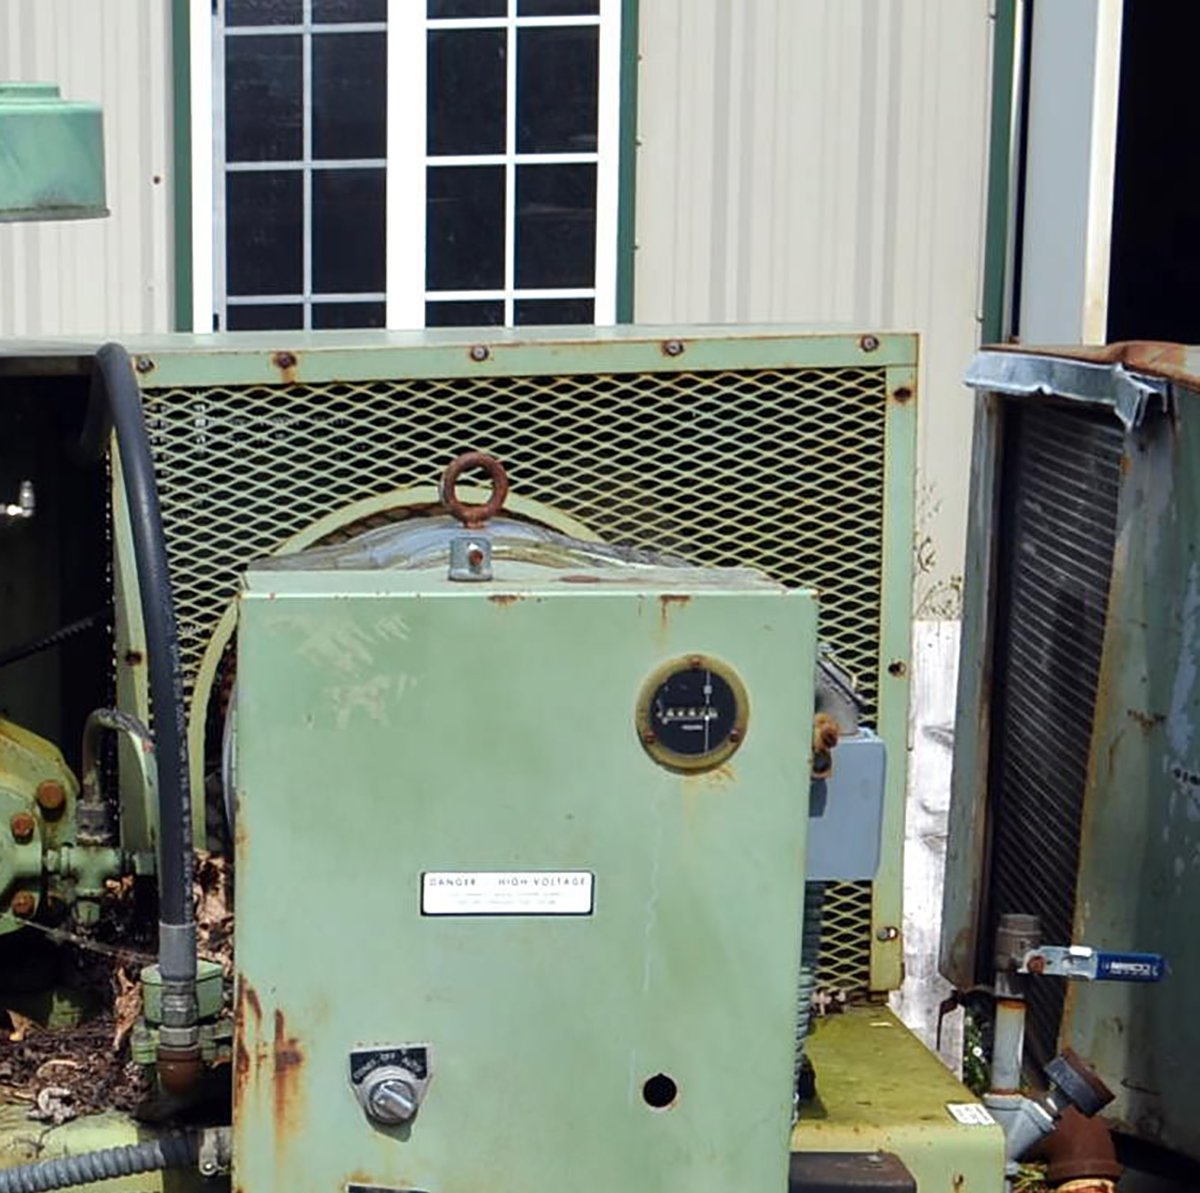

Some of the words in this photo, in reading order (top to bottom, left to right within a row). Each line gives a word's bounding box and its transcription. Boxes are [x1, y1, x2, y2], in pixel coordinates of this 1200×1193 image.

[429, 877, 476, 887] DANGER
[498, 877, 528, 887] HIGH
[534, 877, 586, 887] VOLTAGE
